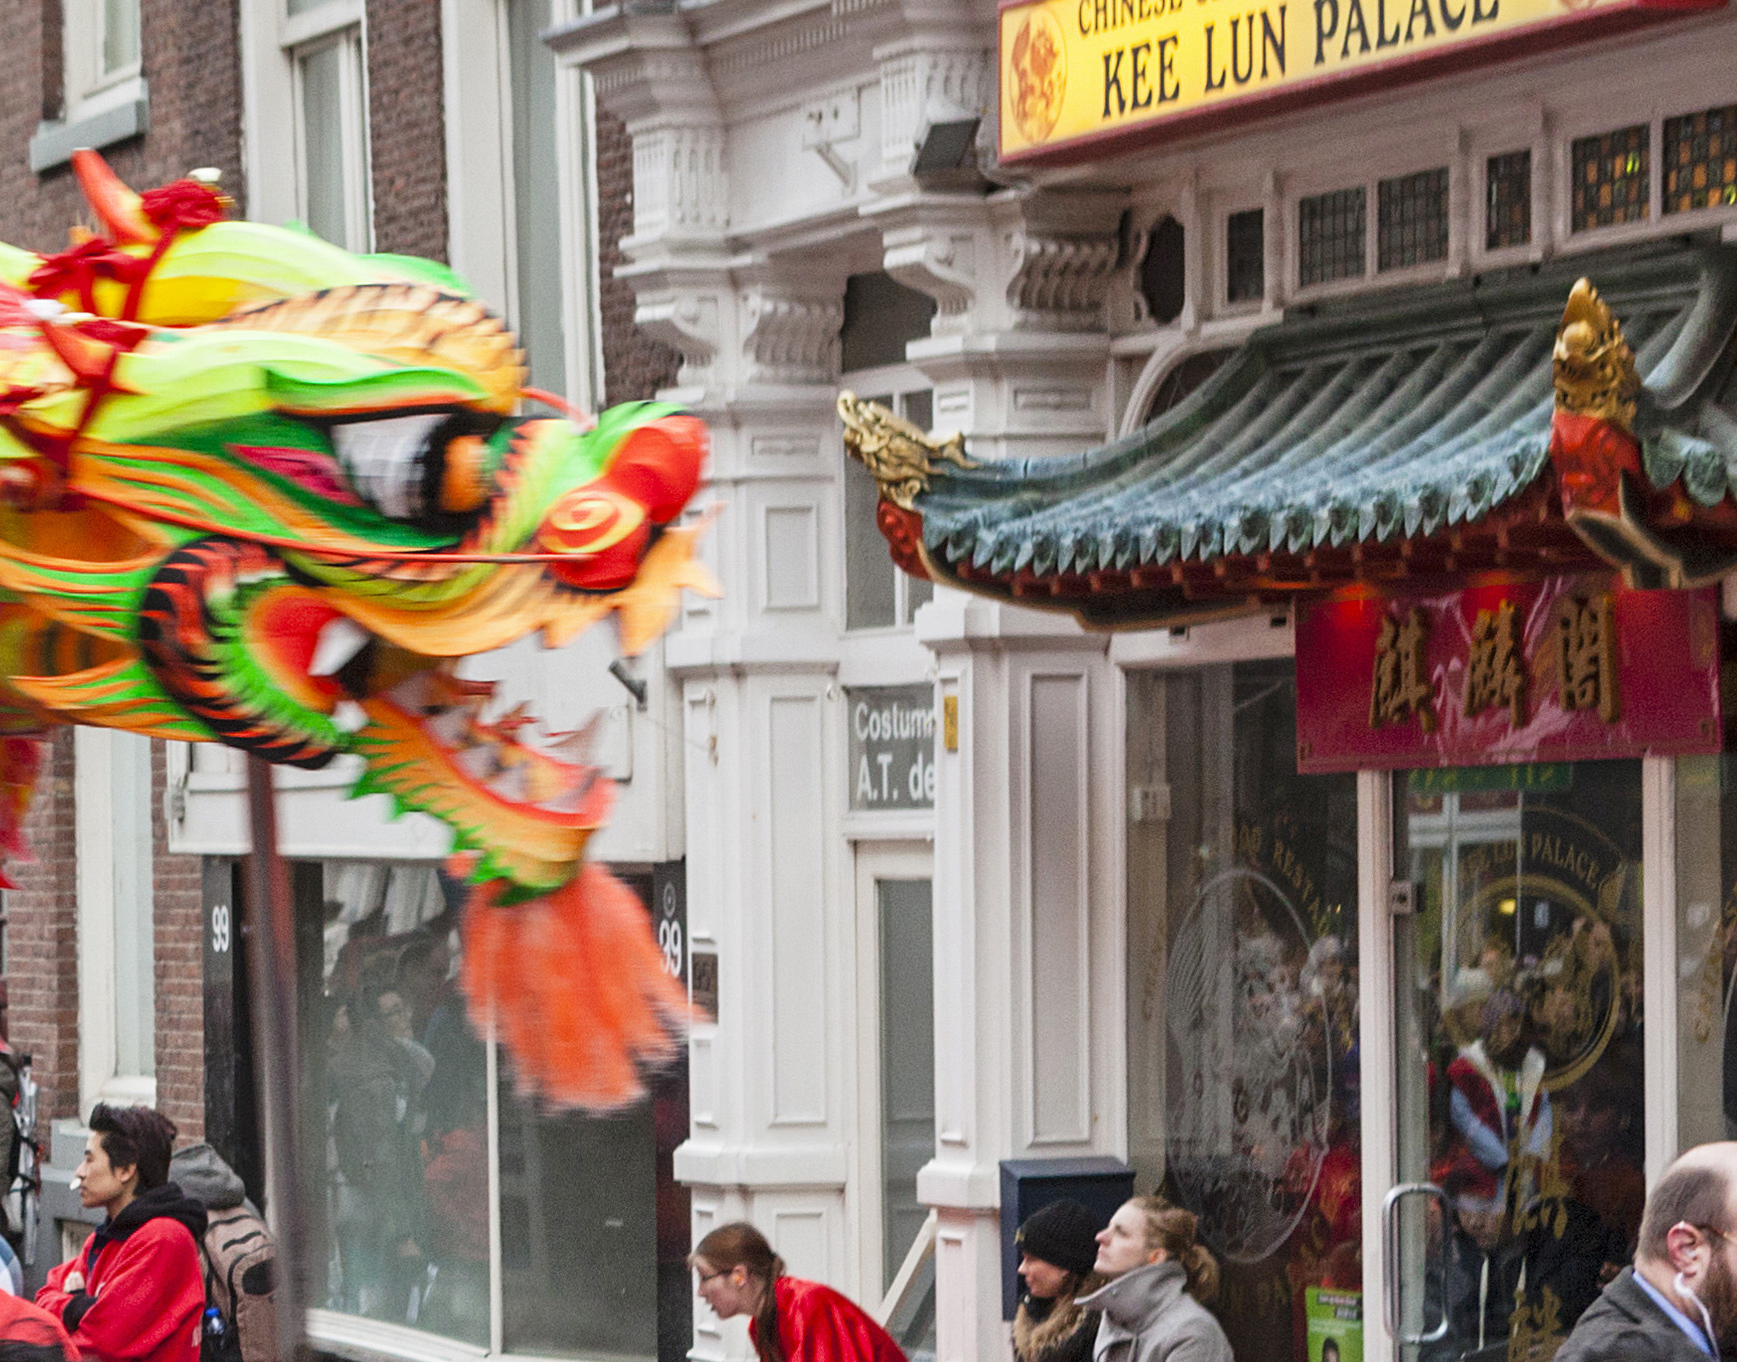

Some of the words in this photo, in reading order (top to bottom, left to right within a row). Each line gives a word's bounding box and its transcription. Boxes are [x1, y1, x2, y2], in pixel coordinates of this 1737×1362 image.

[1102, 35, 1181, 119] KEE
[1204, 5, 1287, 93] LUN
[1369, 597, 1621, 734] 麒麟閣
[857, 753, 899, 800] A.T.
[909, 753, 934, 800] de
[1531, 833, 1601, 890] PALACE
[212, 905, 229, 953] 99
[659, 919, 681, 978] 99
